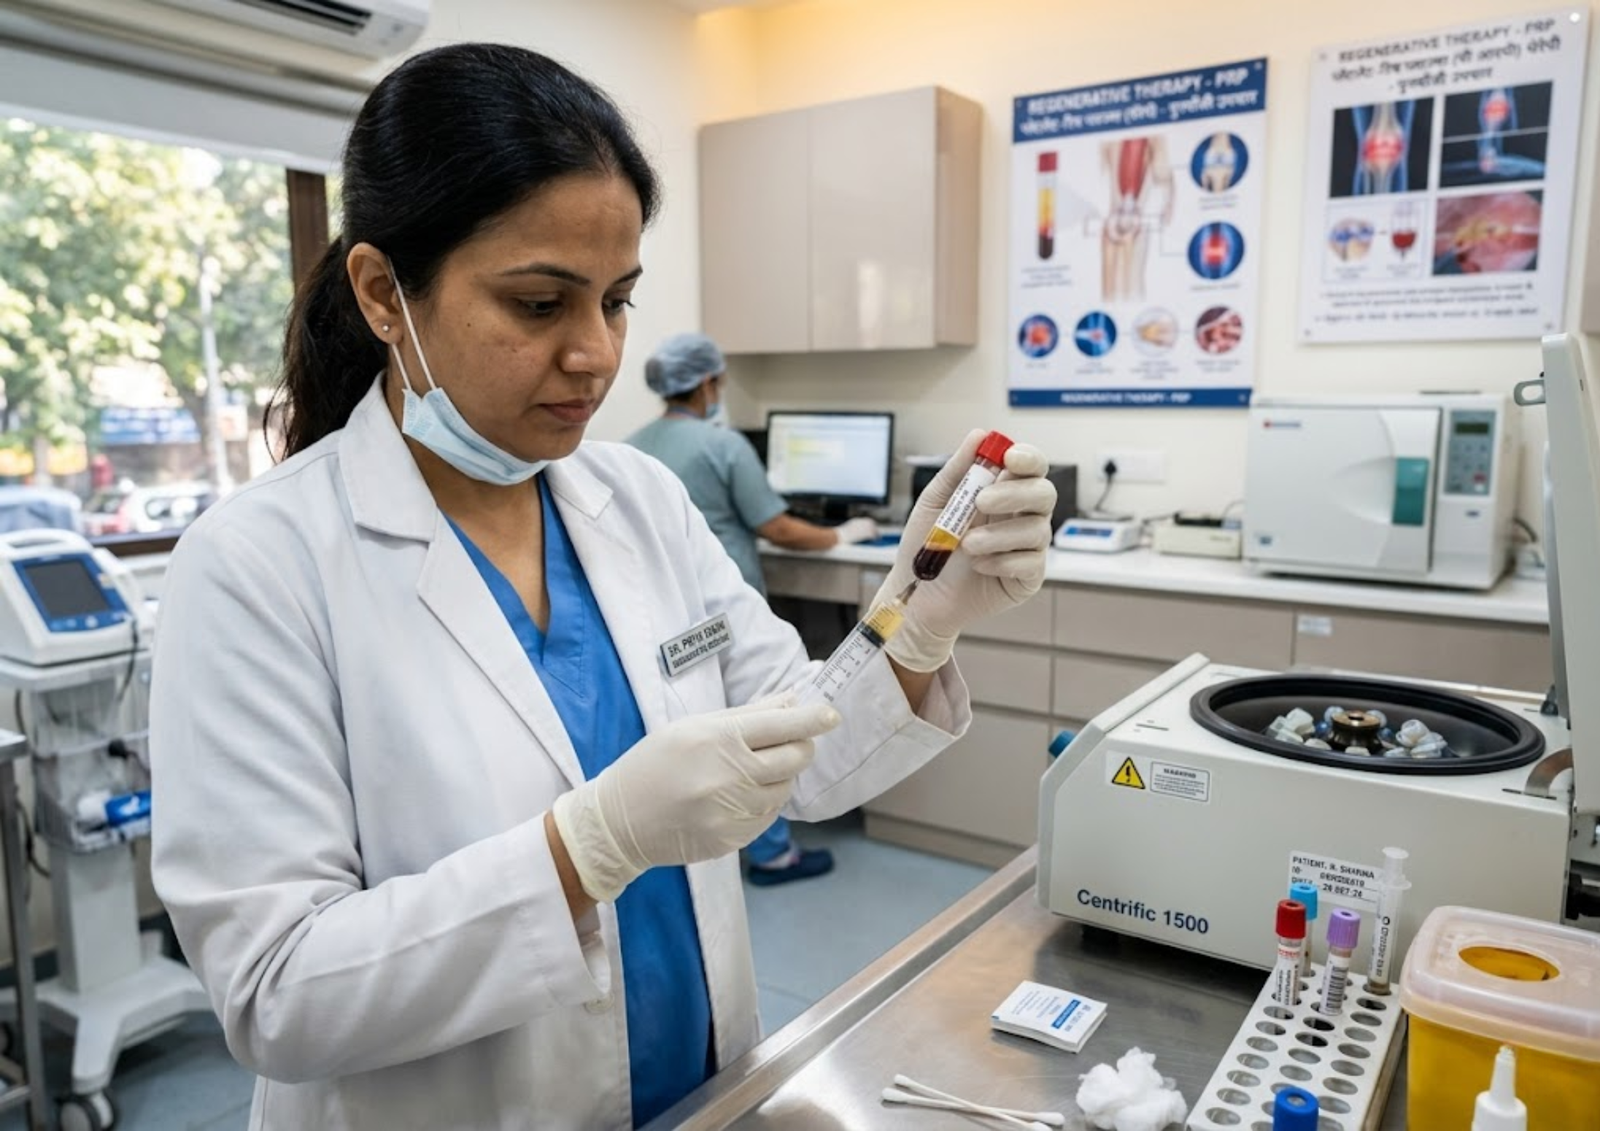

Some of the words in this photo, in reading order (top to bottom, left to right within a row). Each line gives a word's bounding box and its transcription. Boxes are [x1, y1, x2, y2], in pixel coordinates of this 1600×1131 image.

[1445, 25, 1511, 46] THERAPY
[1133, 73, 1202, 100] THERAPY
[1077, 889, 1156, 922] Centrific
[1163, 910, 1209, 934] 1500
